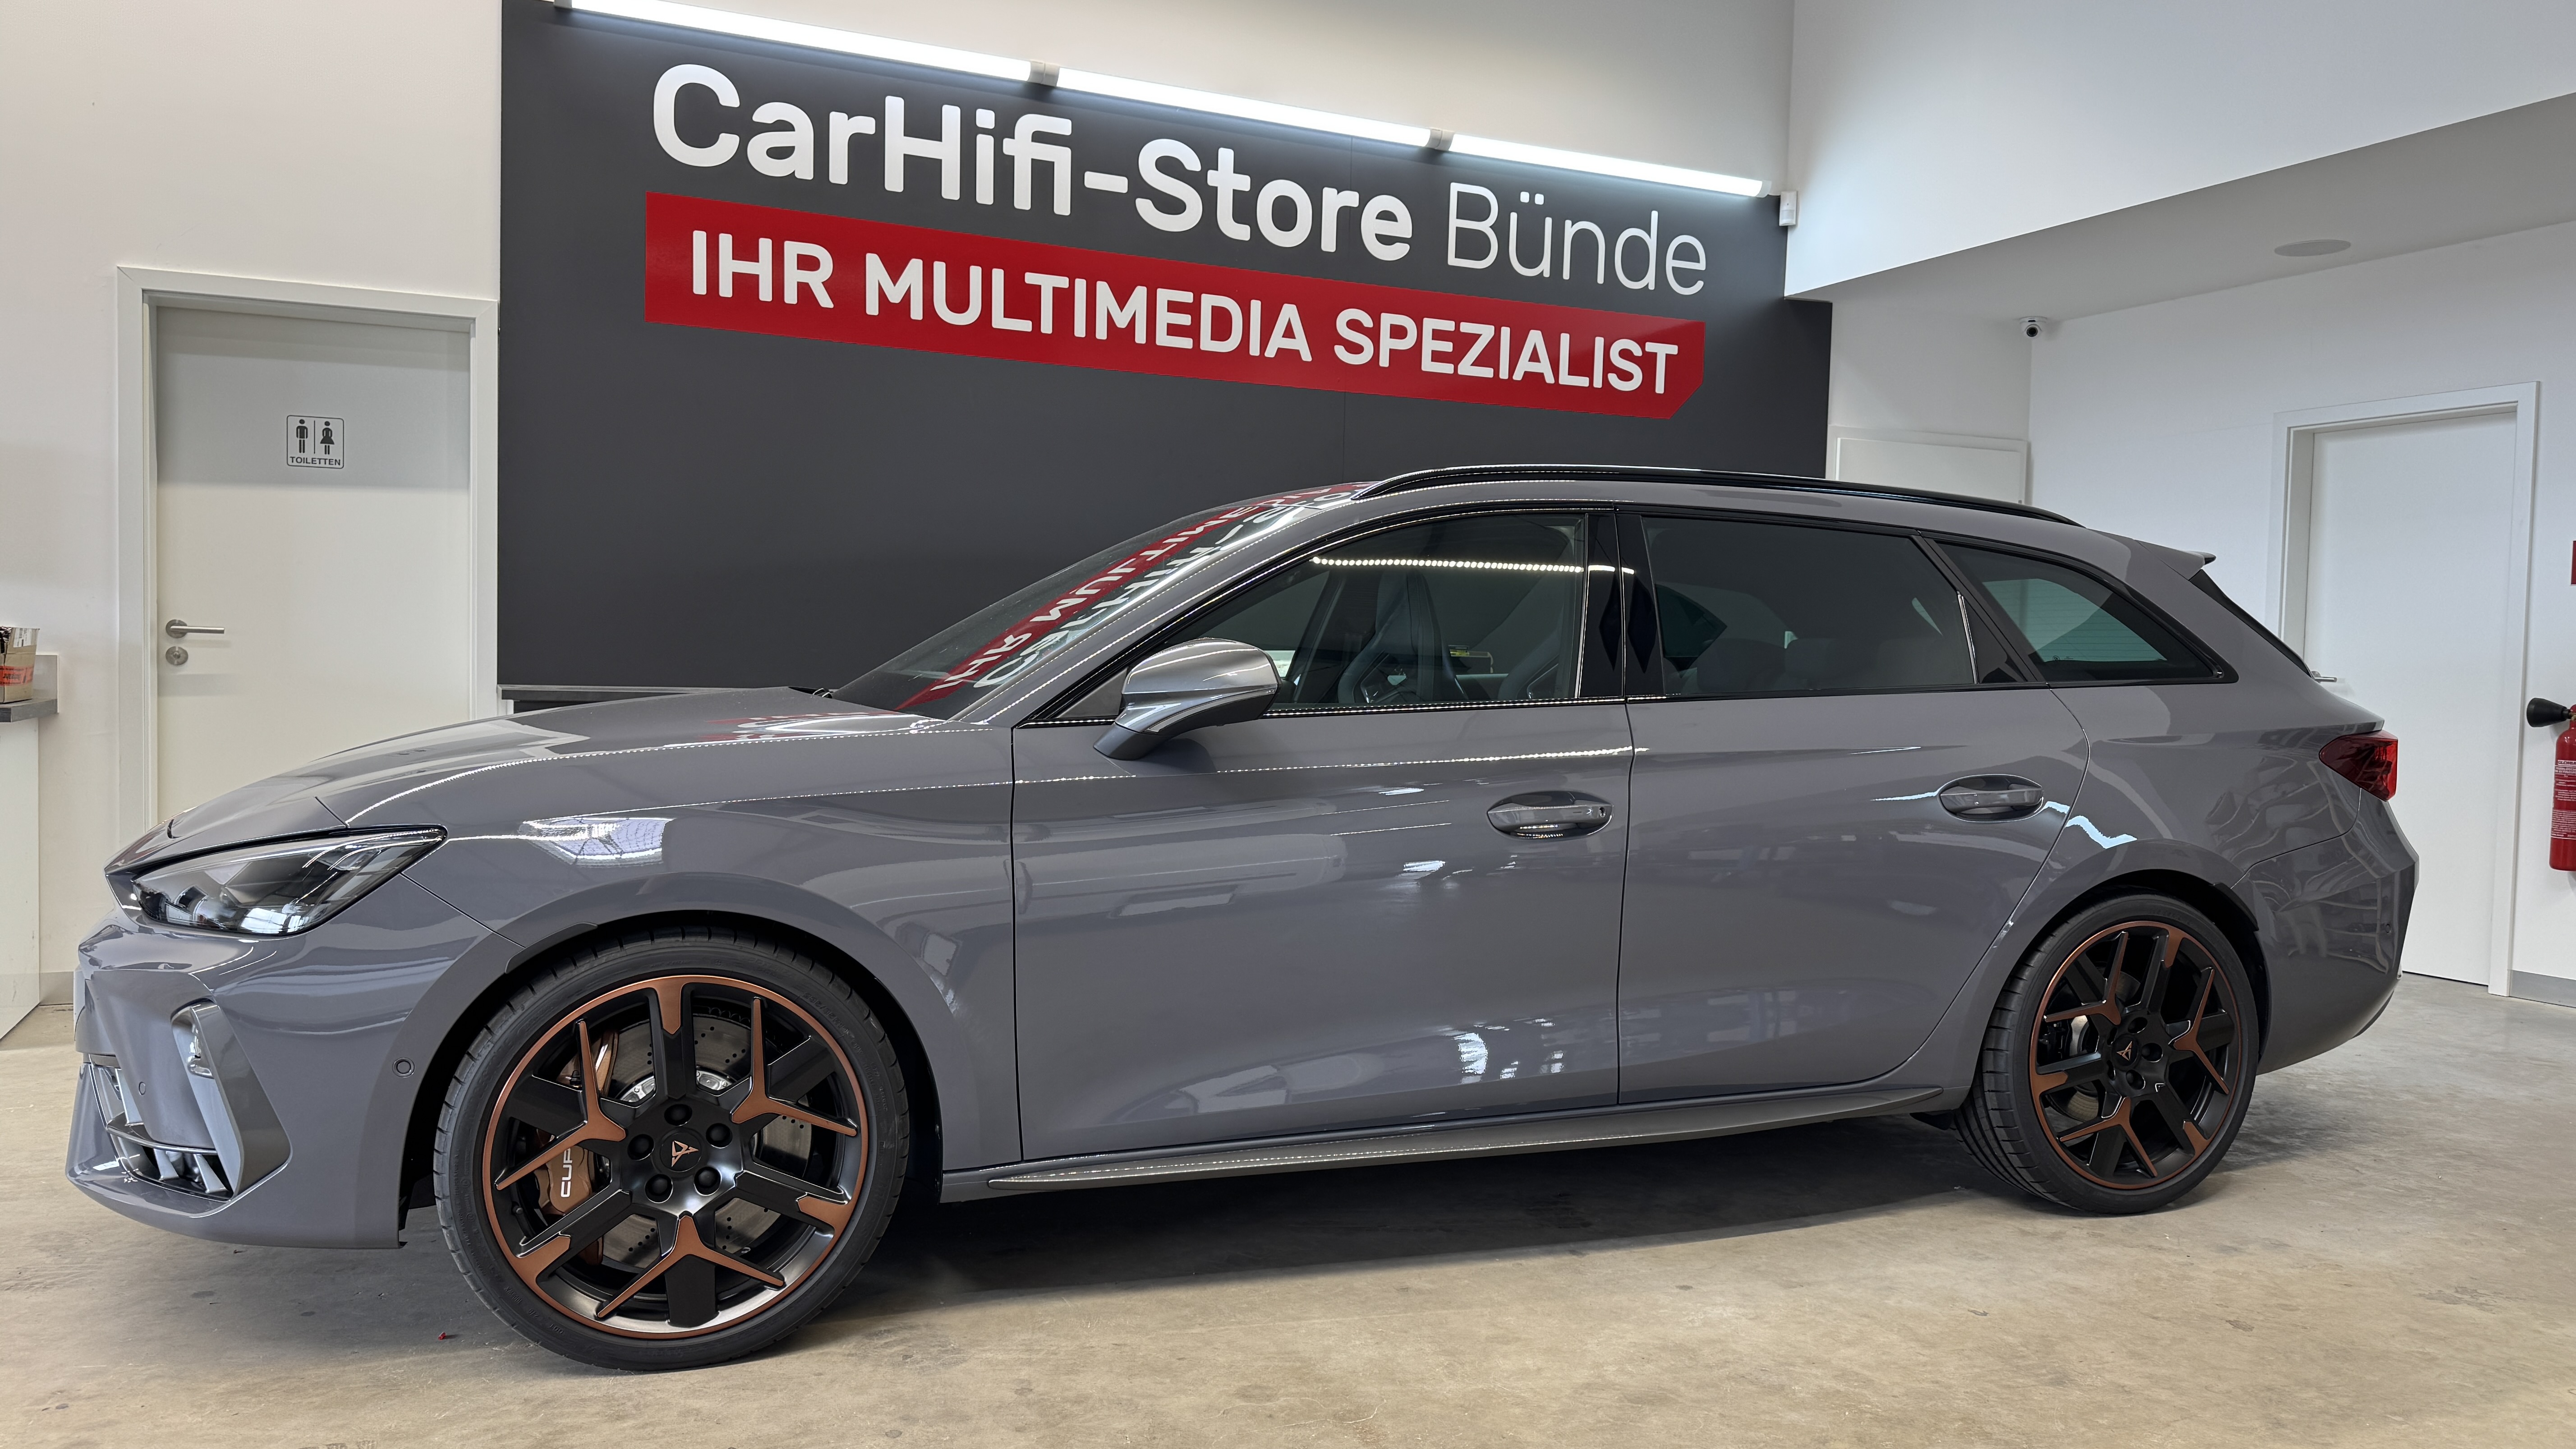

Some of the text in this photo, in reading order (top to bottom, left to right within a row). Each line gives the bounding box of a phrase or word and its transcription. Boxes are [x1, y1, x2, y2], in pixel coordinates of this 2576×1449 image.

[653, 64, 1706, 295] CarHifi-Store Bünde
[693, 230, 1678, 394] IHR MULTIMEDIA SPEZIALIST
[290, 456, 341, 466] TOILETTEN
[561, 1147, 573, 1197] CUP
